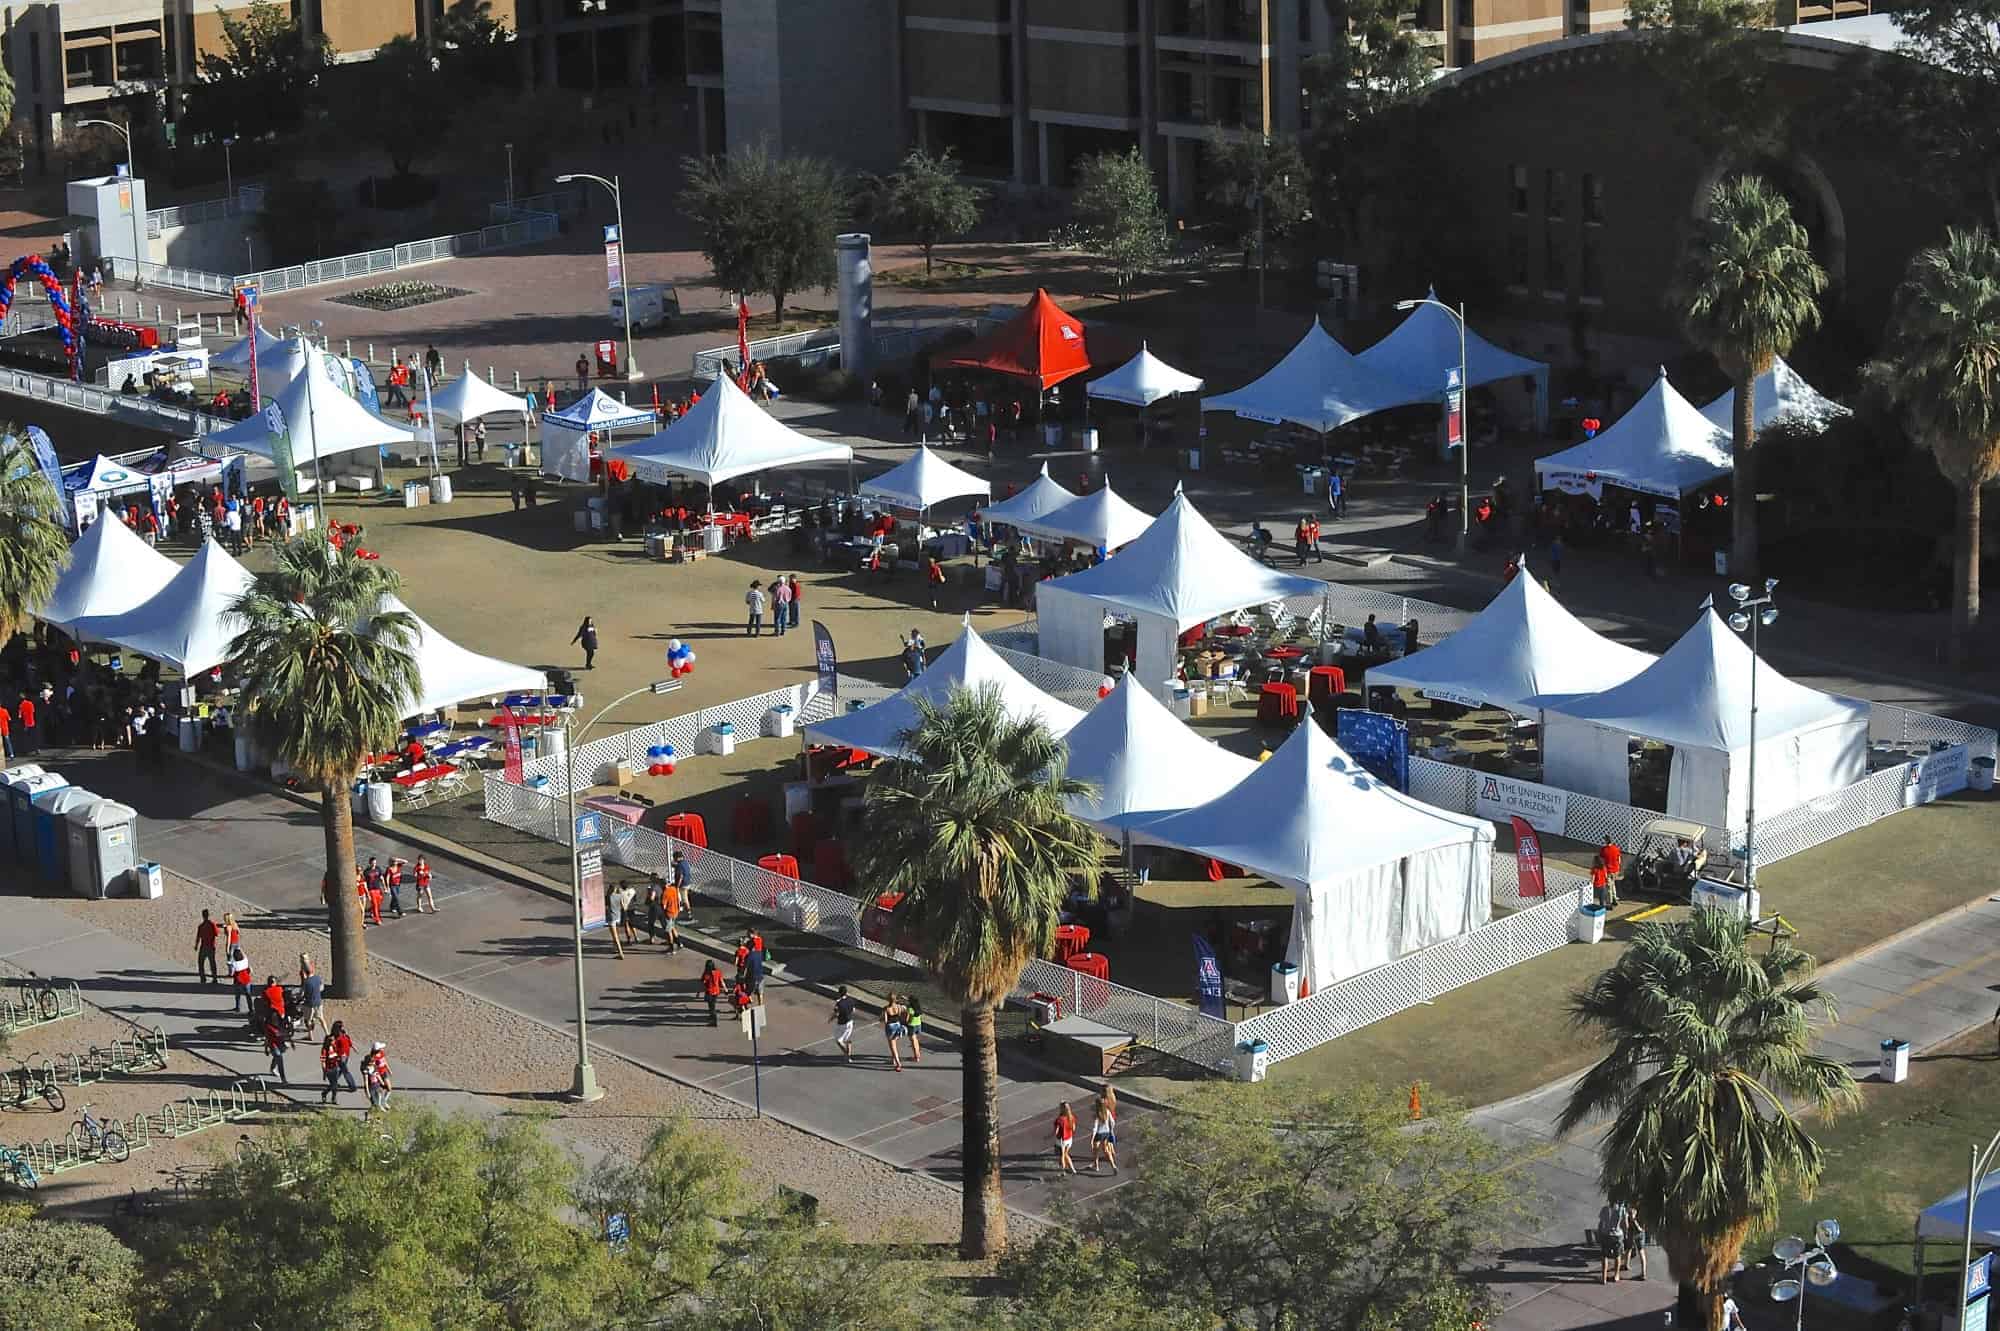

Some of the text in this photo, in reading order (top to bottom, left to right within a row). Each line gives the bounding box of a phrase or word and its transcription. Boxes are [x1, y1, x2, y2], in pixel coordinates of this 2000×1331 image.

[1501, 783, 1562, 804] THE UNIVERSITY
[1506, 796, 1556, 815] OF ARIZONA
